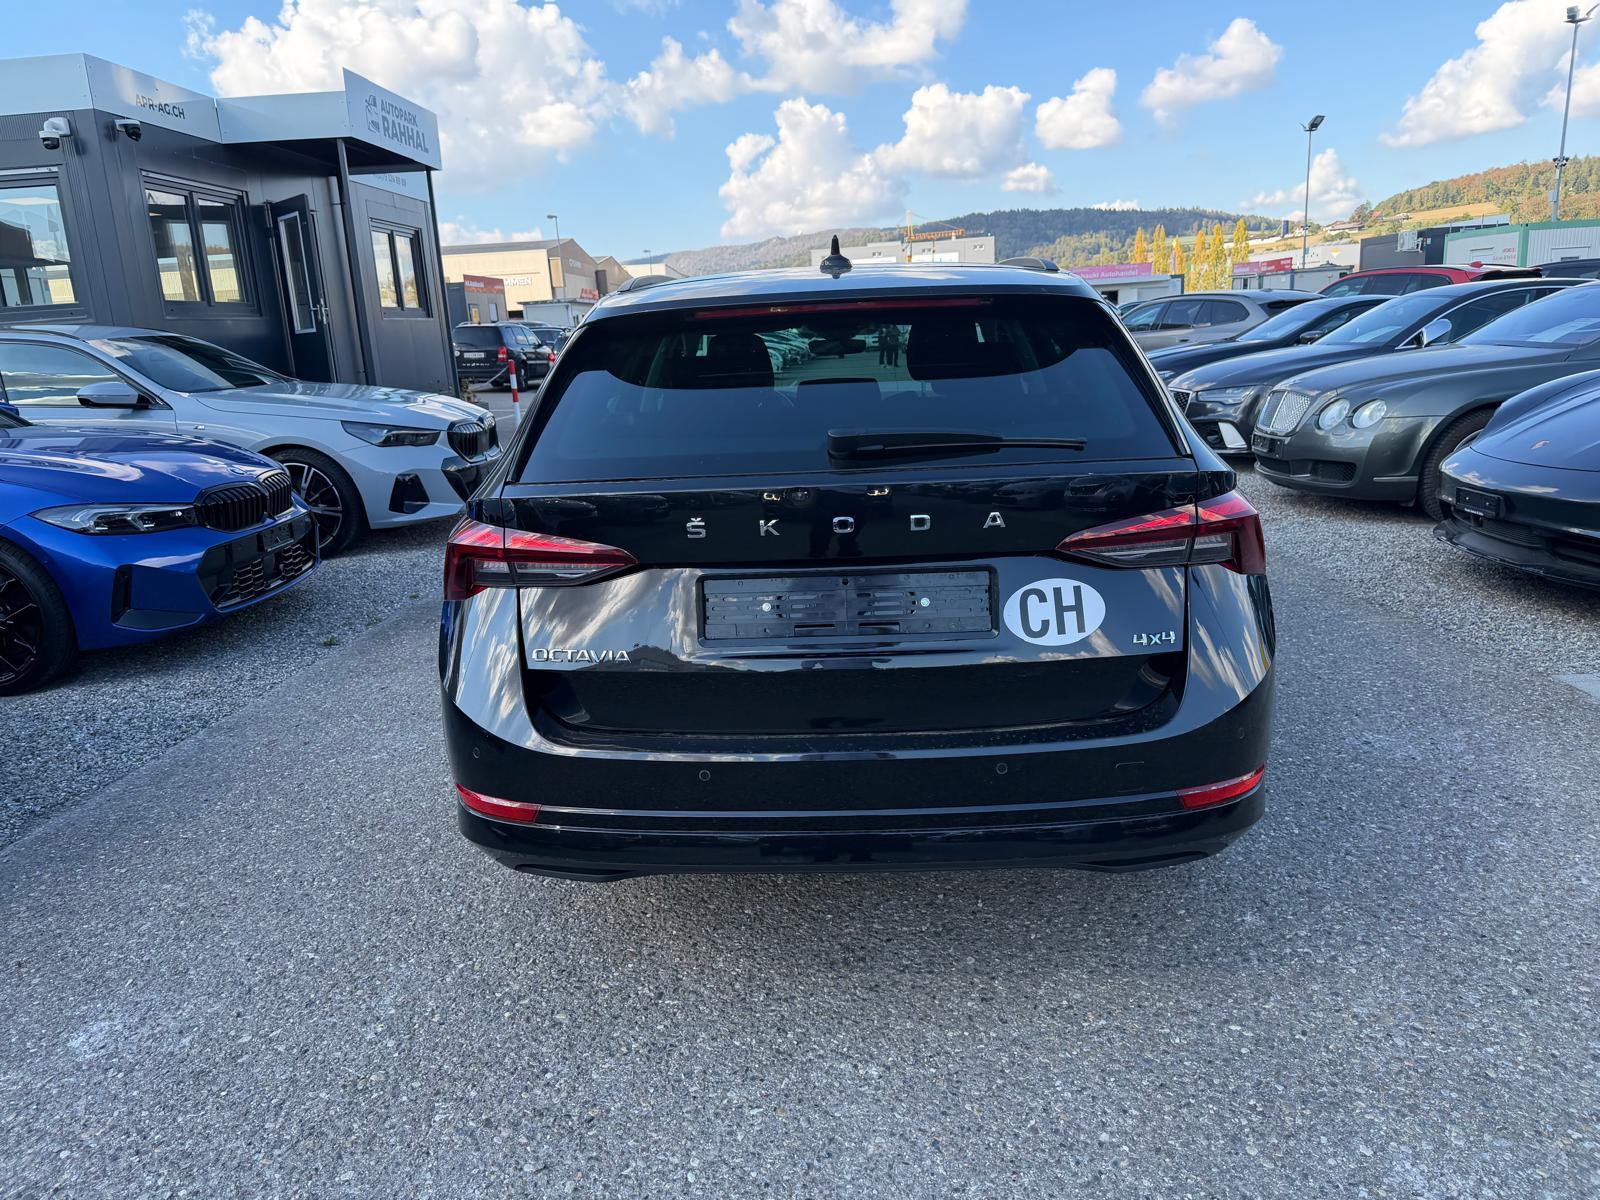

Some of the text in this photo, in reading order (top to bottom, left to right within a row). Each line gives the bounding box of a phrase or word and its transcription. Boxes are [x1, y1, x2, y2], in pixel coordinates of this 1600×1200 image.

[136, 94, 186, 119] APR-AG.CH
[380, 99, 418, 127] AUTOPARK
[381, 115, 430, 154] RAHHAL
[1018, 584, 1088, 640] CH
[1132, 630, 1177, 646] 4x4
[532, 648, 632, 664] OCTAVIA
